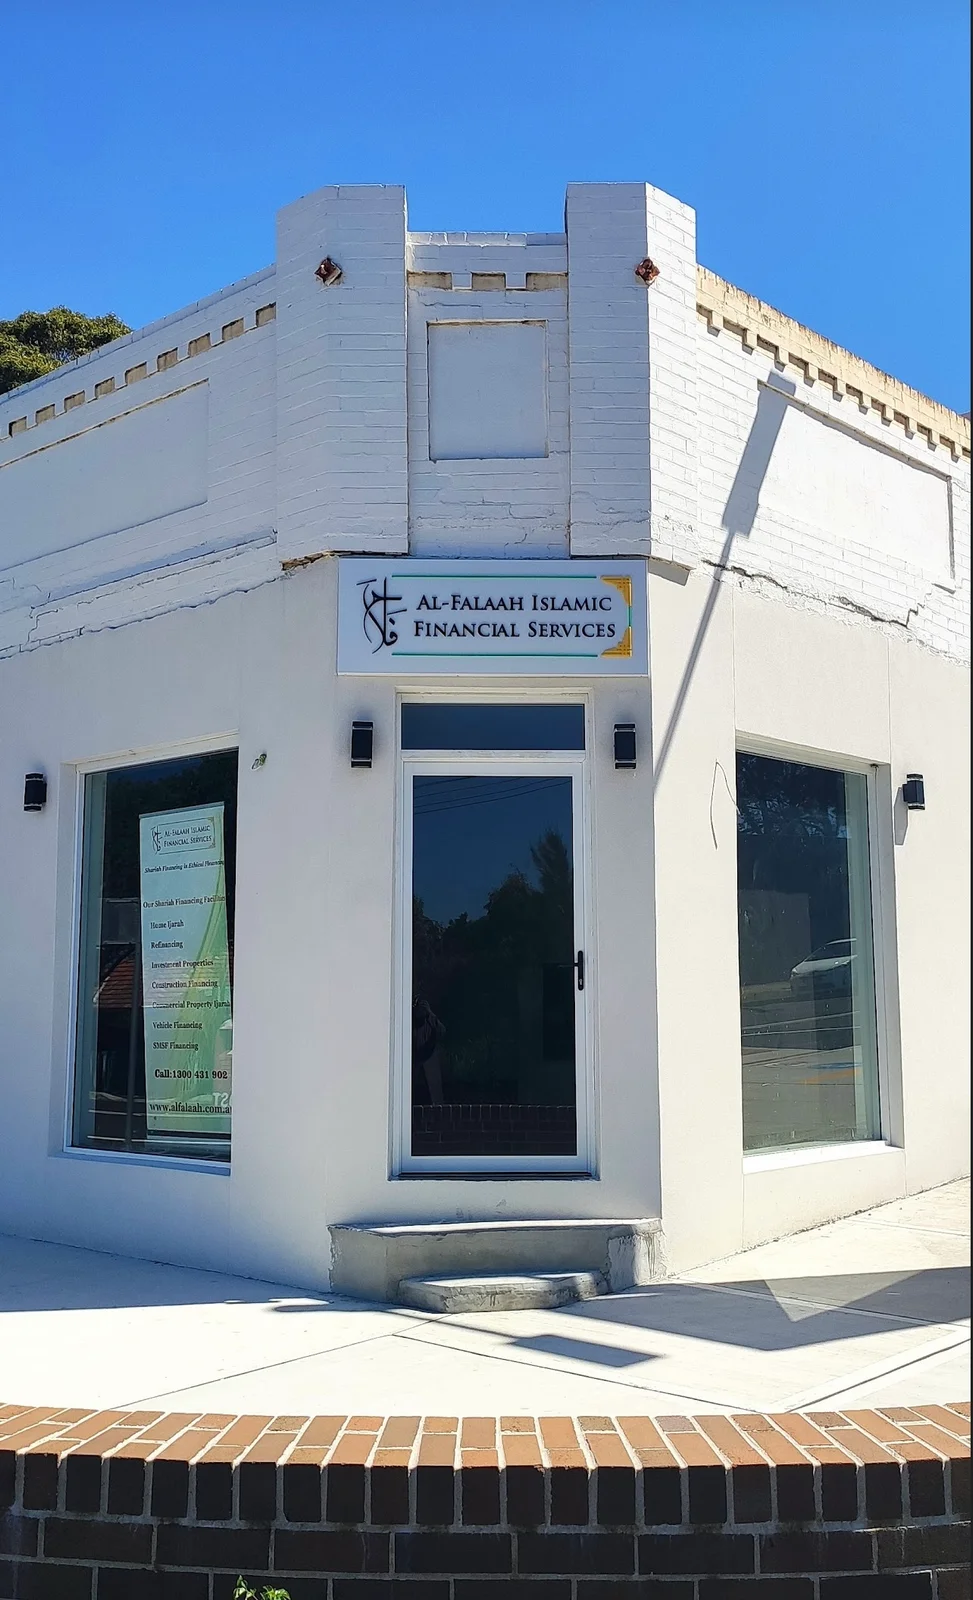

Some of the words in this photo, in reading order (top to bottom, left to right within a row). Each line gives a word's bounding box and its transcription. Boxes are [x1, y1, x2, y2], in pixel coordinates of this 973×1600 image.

[416, 594, 524, 612] AL-FALAAH
[531, 595, 612, 611] ISLAMIC
[414, 621, 520, 637] FINANCIAL
[528, 621, 616, 638] SERVICES
[191, 825, 211, 834] ISLAMIC
[164, 838, 190, 847] FINANCIAL
[190, 835, 212, 844] SERVICES
[162, 864, 183, 872] Financing
[154, 899, 174, 907] Shariah
[175, 896, 203, 905] Financing
[167, 919, 184, 929] Ijarah
[151, 940, 183, 949] Refinancing
[151, 961, 181, 969] Investment
[182, 959, 214, 969] Properties
[151, 980, 187, 989] Construction
[188, 979, 218, 988] Financing
[152, 1000, 185, 1008] Commercial
[186, 1000, 213, 1009] Property
[173, 1021, 203, 1030] Financing
[169, 1041, 199, 1050] Financing
[155, 1069, 192, 1079] Call:1300
[194, 1070, 209, 1079] 431
[212, 1070, 228, 1079] 902
[149, 1101, 232, 1113] www.alfalaah.com.a
